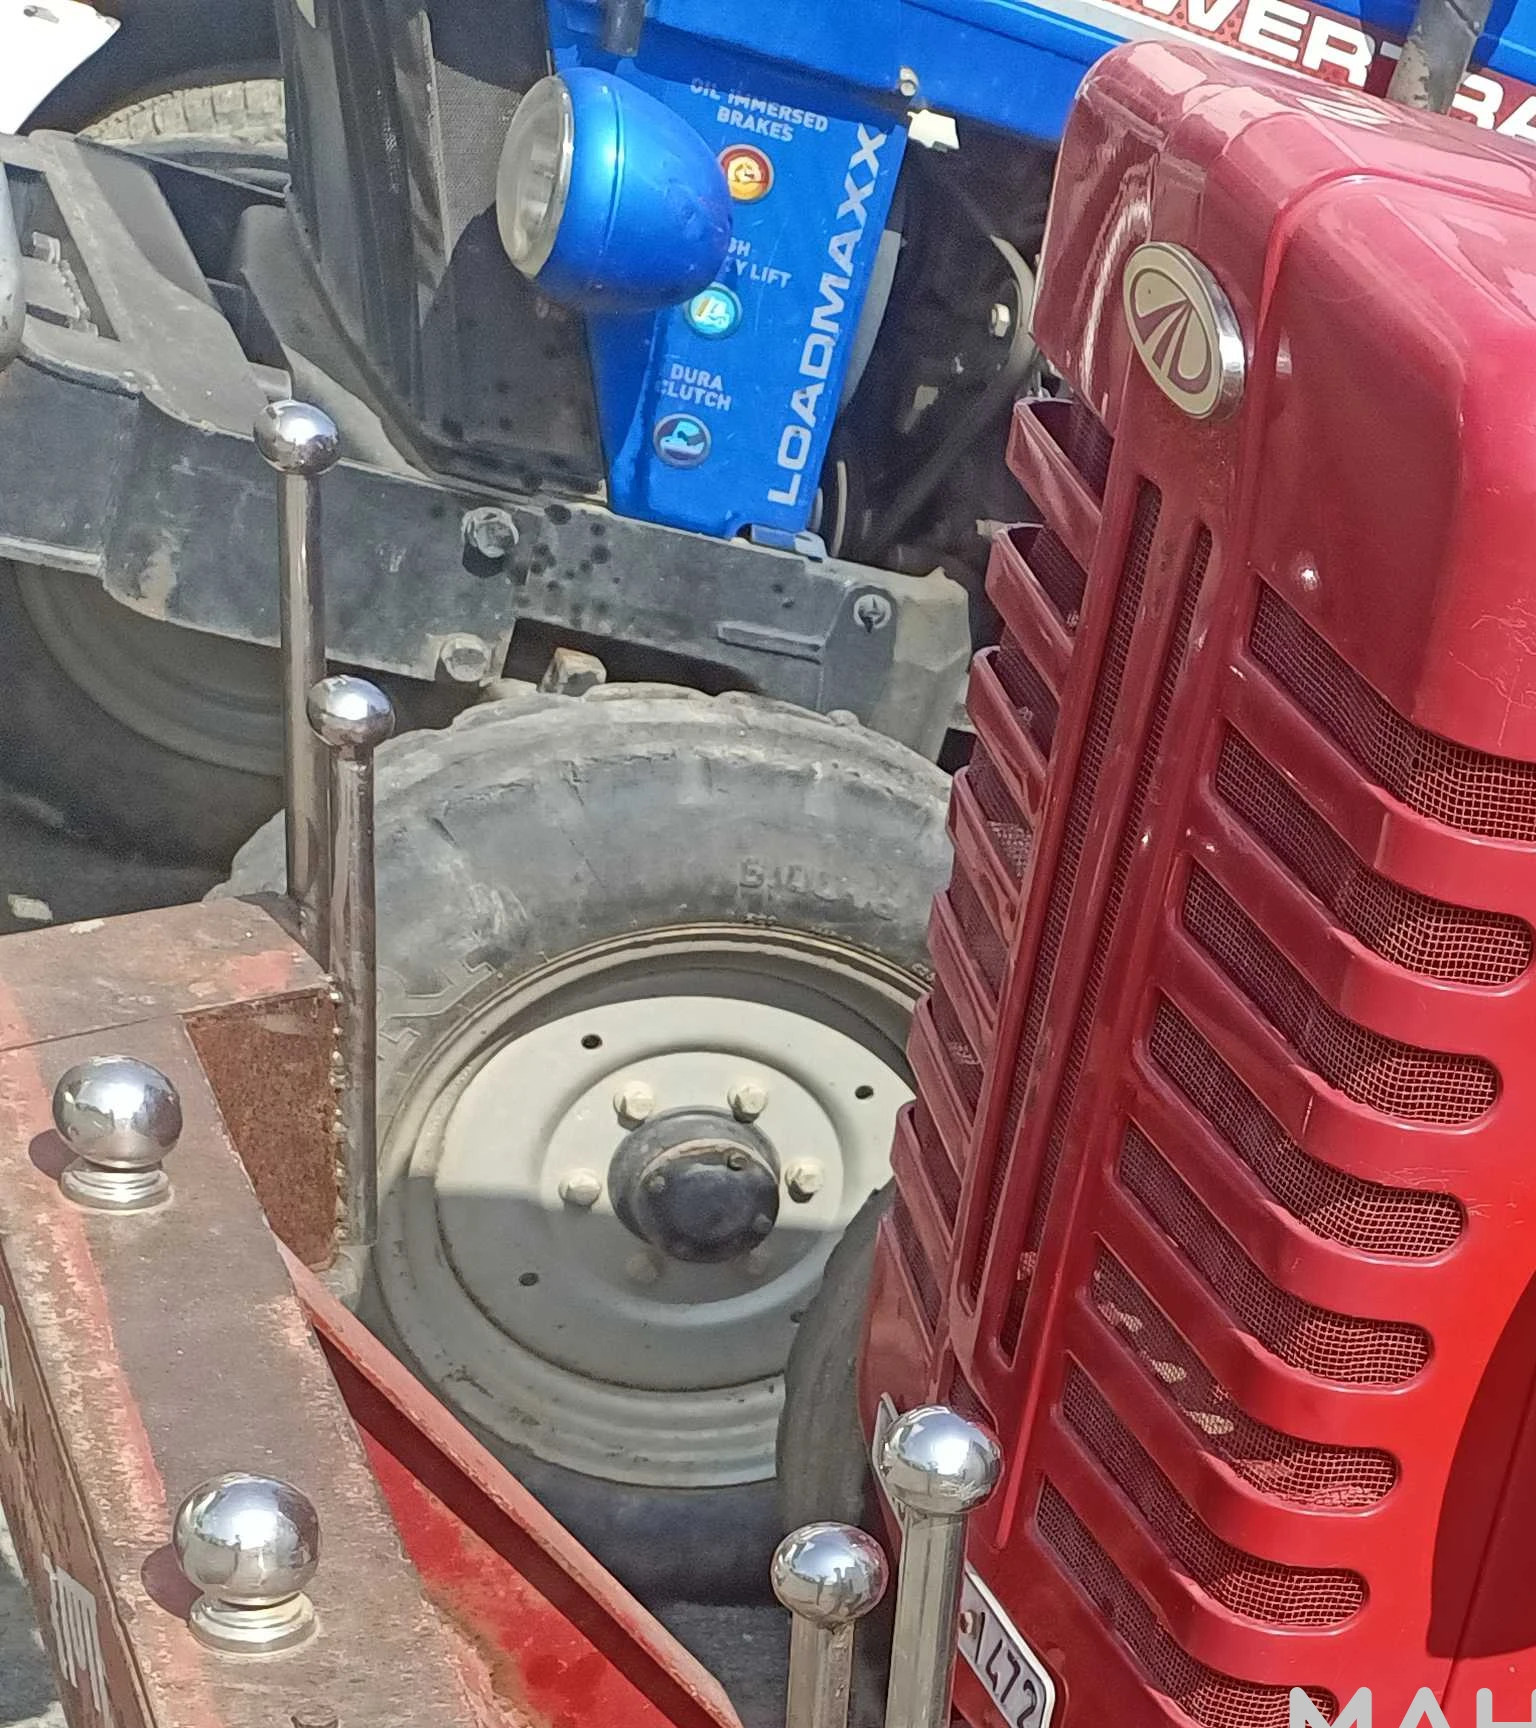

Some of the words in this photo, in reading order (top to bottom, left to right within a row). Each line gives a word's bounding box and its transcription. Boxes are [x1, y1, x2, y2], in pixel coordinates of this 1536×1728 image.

[690, 78, 720, 100] OIL
[727, 88, 828, 132] IMMERSED
[716, 105, 794, 142] BRAKES
[750, 264, 792, 288] LIFT
[767, 123, 887, 506] LOADMAXX
[670, 363, 723, 391] DURA
[655, 379, 732, 411] CLUTCH
